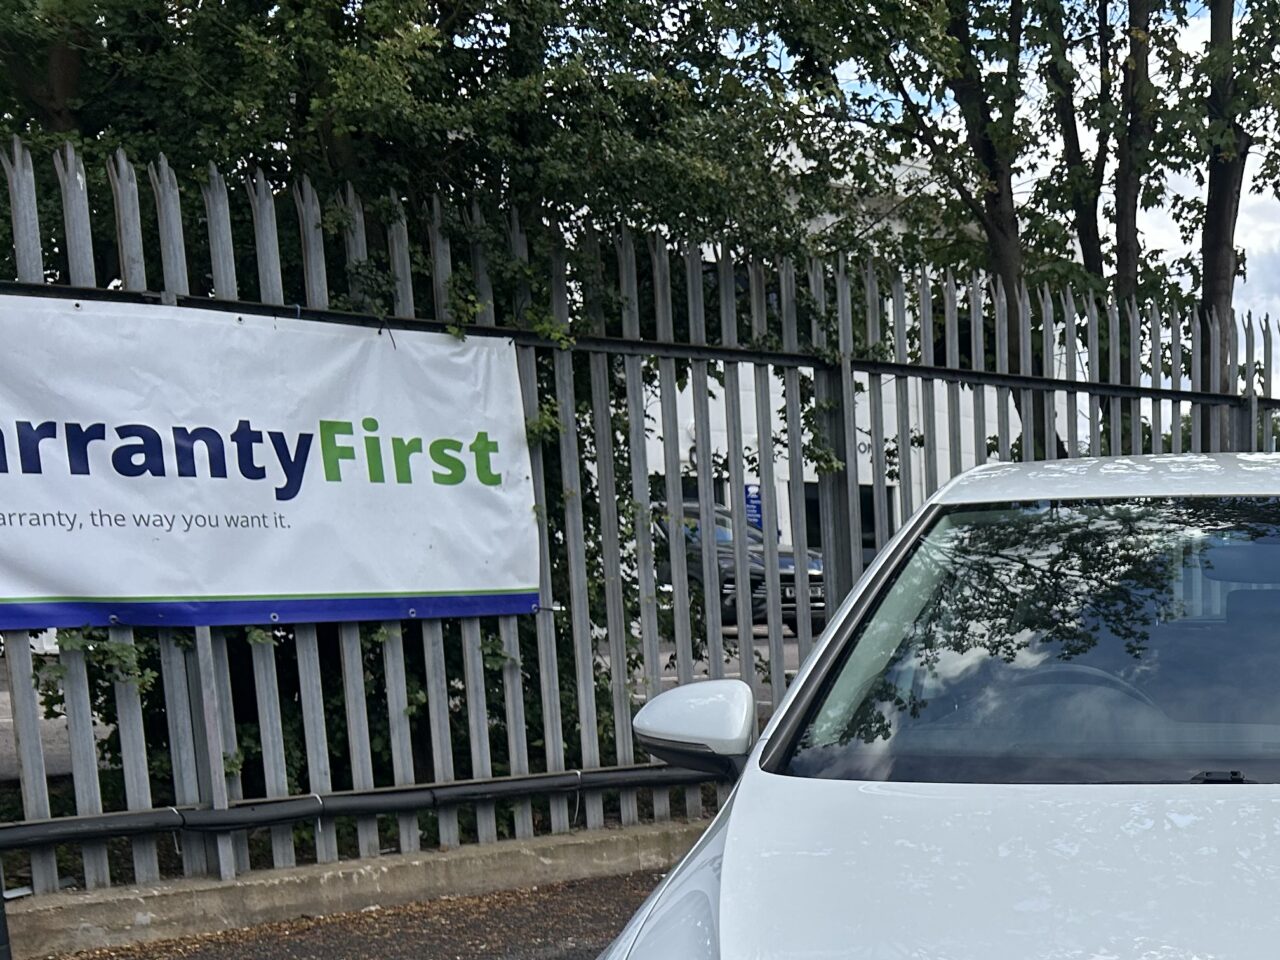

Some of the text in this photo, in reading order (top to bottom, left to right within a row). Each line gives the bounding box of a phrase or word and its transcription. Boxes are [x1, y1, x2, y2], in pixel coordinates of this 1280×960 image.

[0, 418, 502, 501] rrantyFirst
[90, 508, 126, 528] the
[132, 513, 176, 533] way
[181, 513, 220, 533] you
[224, 512, 269, 529] want
[273, 511, 291, 529] it.
